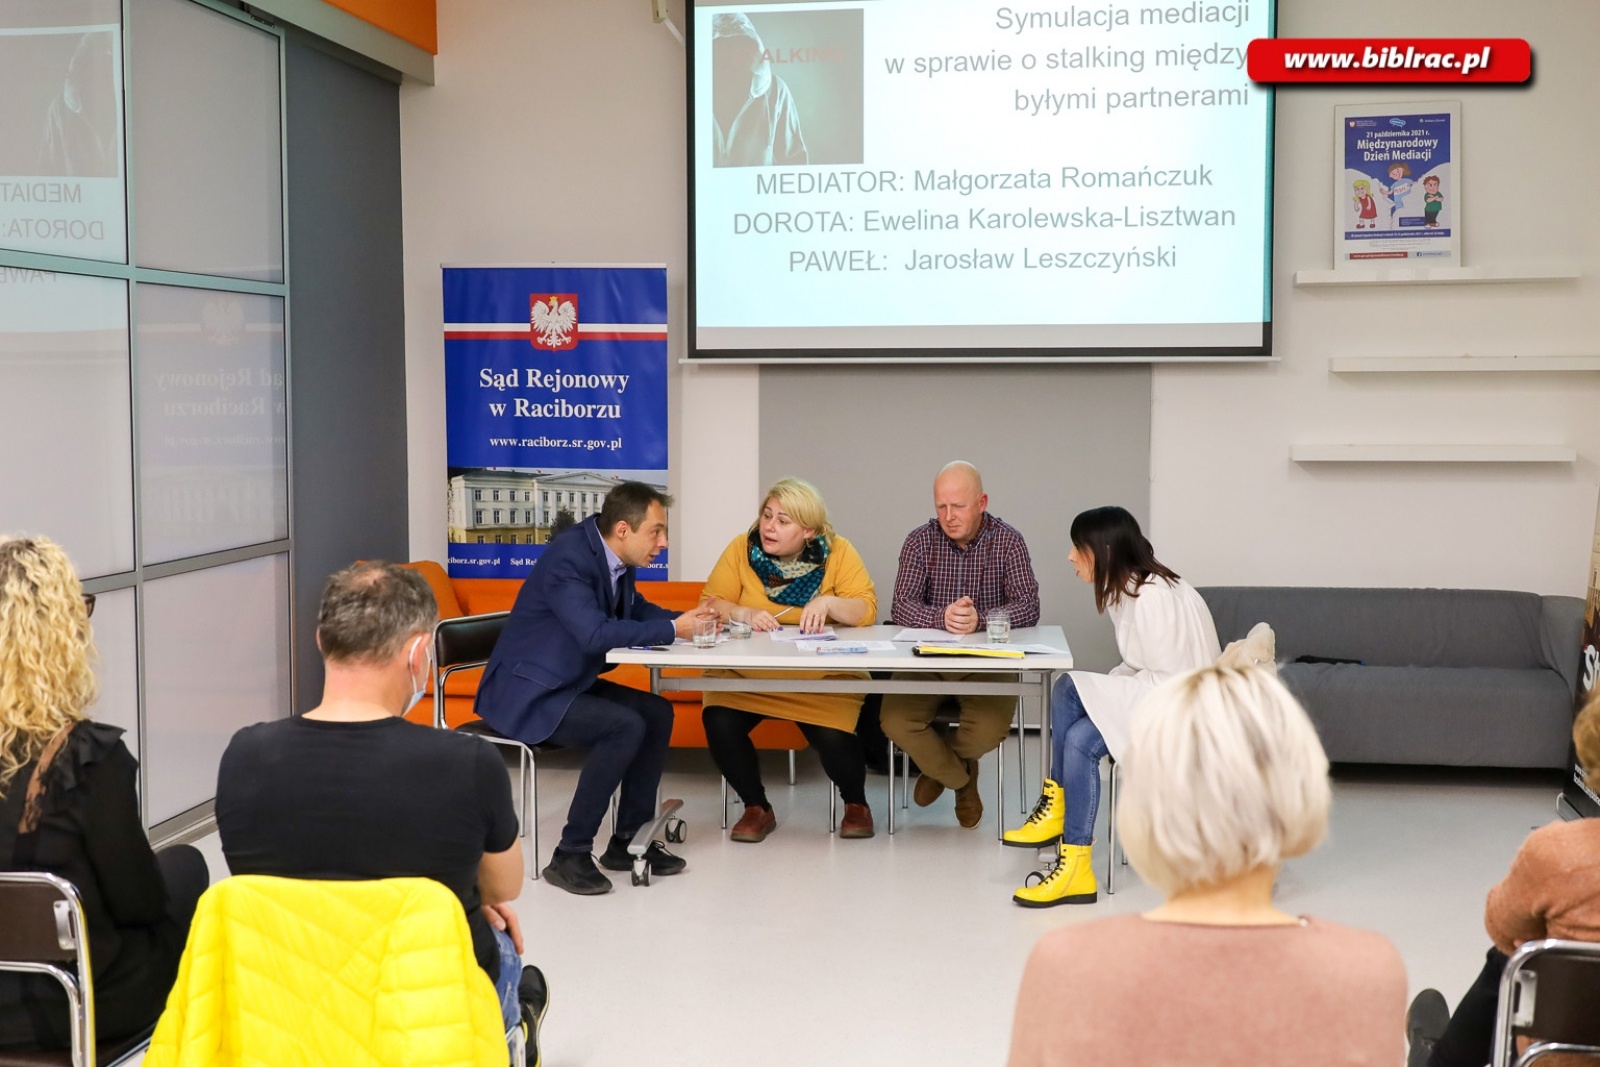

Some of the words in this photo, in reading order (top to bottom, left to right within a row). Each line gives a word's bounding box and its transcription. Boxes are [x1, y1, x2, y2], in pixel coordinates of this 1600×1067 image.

[995, 5, 1130, 35] Symulacja
[1140, 0, 1250, 28] mediacji
[884, 57, 906, 74] w
[913, 51, 1013, 78] sprawie
[1021, 54, 1037, 70] o
[1046, 46, 1145, 73] stalking
[1155, 42, 1248, 72] między
[1014, 87, 1097, 118] byłymi
[1106, 85, 1249, 115] partnerami
[1357, 138, 1438, 151] Międzynarodowy
[1363, 151, 1390, 161] Dzień
[1392, 149, 1432, 161] Mediacji
[756, 171, 904, 195] MEDIATOR:
[914, 169, 1052, 197] Małgorzata
[1061, 165, 1214, 189] Romańczuk
[733, 210, 854, 235] DOROTA:
[863, 208, 960, 232] Ewelina
[969, 206, 1236, 230] Karolewska-Lisztwan
[789, 249, 888, 273] PAWEŁ:
[904, 247, 1015, 271] Jarosław
[1023, 246, 1177, 274] Leszczyński
[479, 368, 519, 391] Sąd
[526, 368, 630, 393] Rejonowy
[489, 403, 507, 417] w
[513, 398, 622, 419] Raciborzu
[489, 436, 623, 451] www.raciborz.sr.gov.pl
